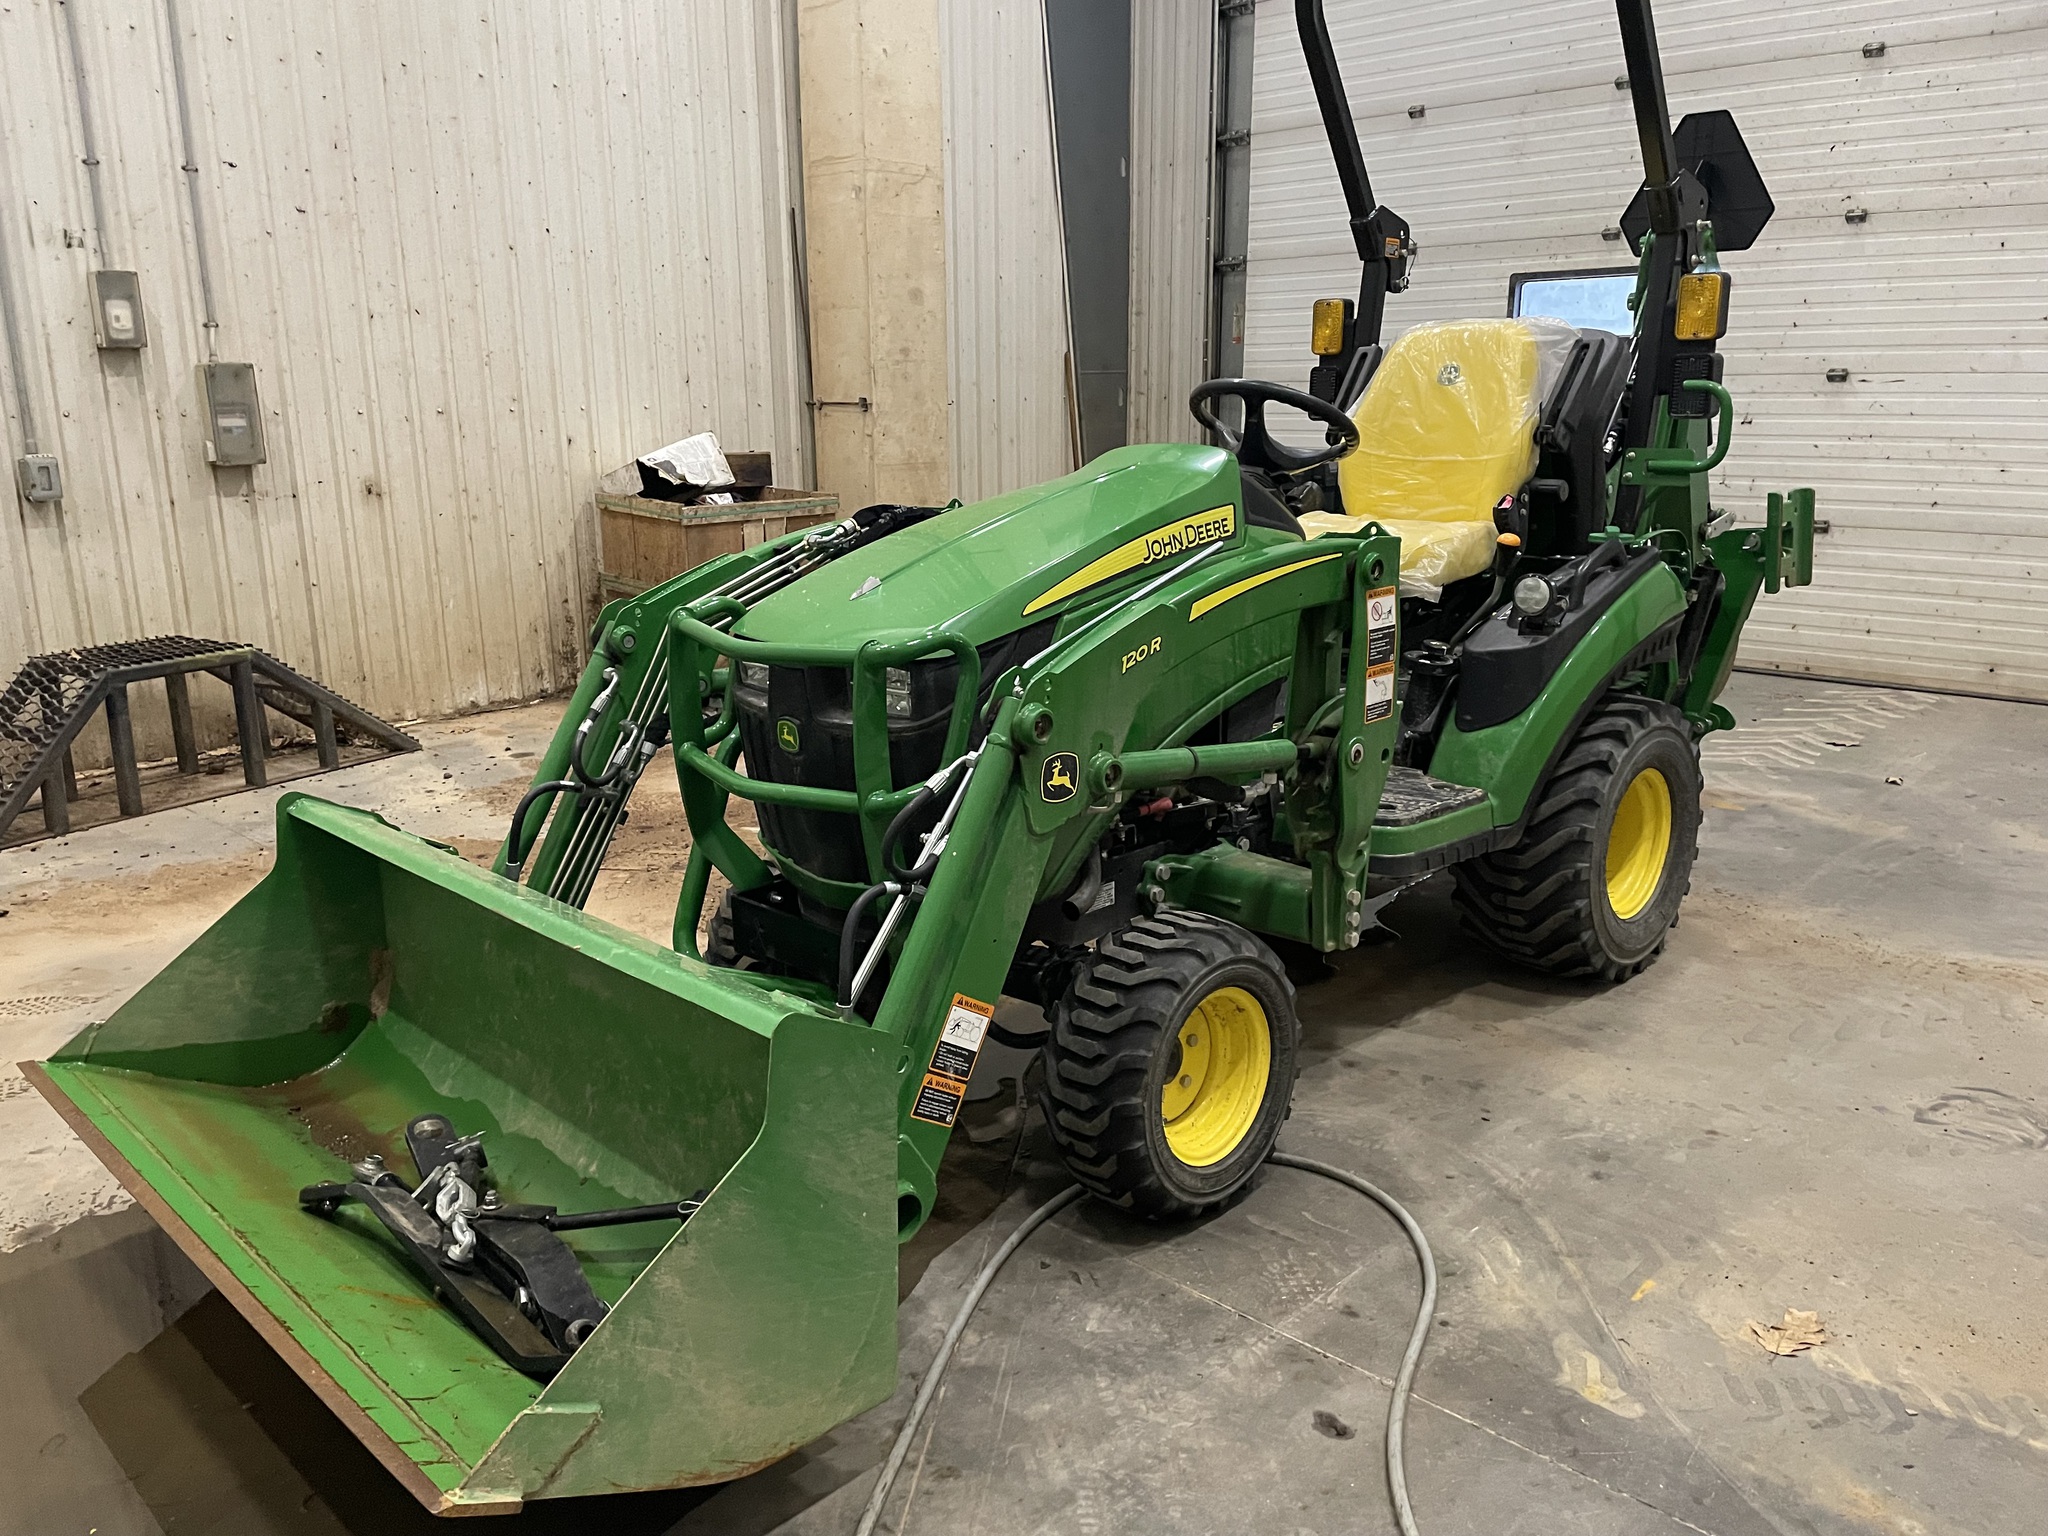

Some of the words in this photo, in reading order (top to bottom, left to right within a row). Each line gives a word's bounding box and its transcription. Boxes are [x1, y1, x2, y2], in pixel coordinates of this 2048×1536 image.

[1143, 531, 1184, 562] JOHN
[1184, 517, 1230, 545] DEERE
[1121, 644, 1148, 674] 120
[1150, 636, 1162, 655] R
[964, 999, 990, 1014] WARNING
[935, 1080, 961, 1093] WARNING
